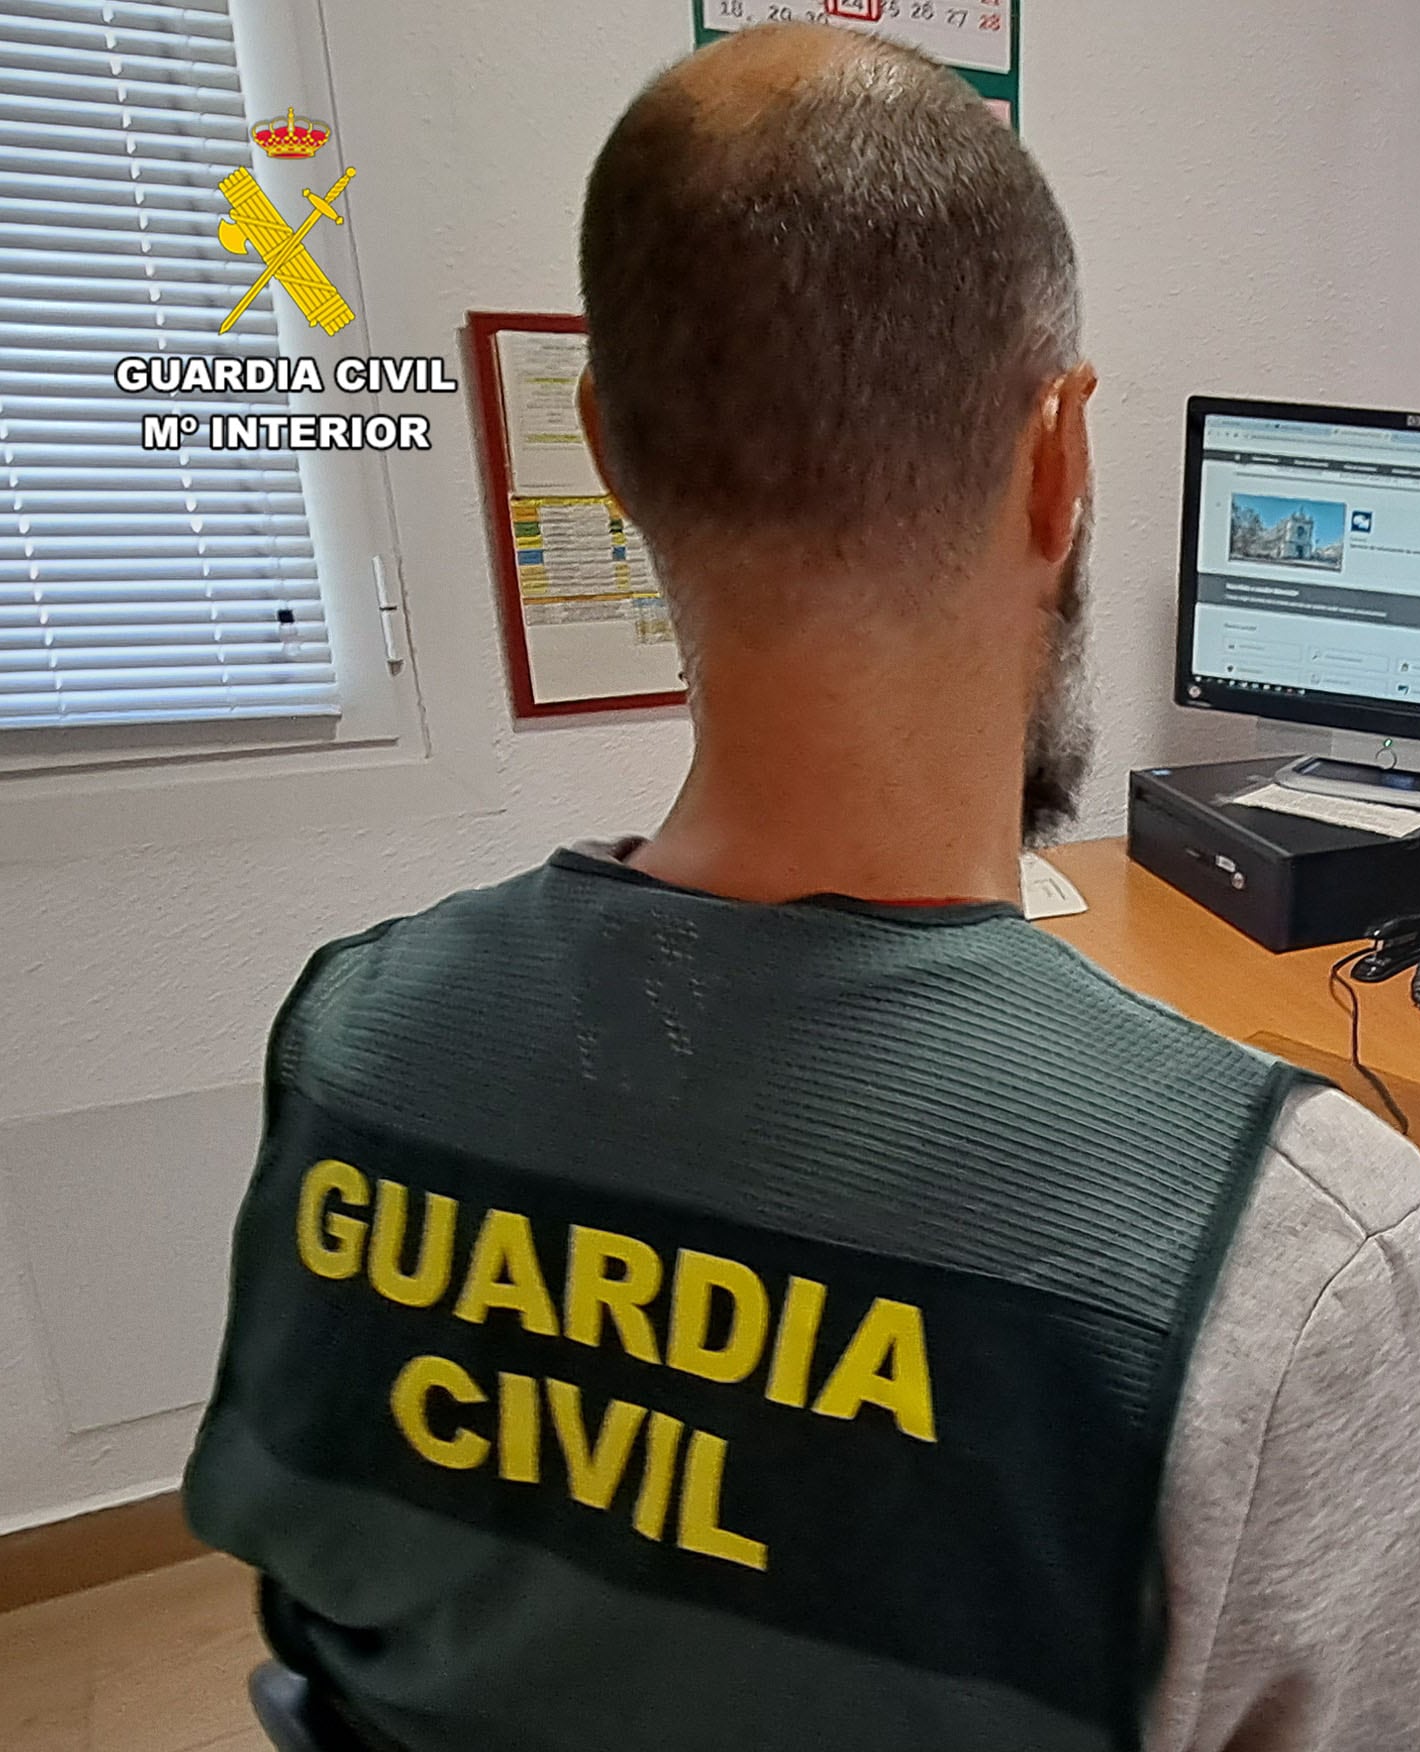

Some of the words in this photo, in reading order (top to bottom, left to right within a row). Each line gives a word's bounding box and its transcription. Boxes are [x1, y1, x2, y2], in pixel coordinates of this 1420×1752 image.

[946, 8, 968, 28] 27
[296, 1158, 939, 1443] GUARDIA
[389, 1355, 770, 1573] CIVIL
